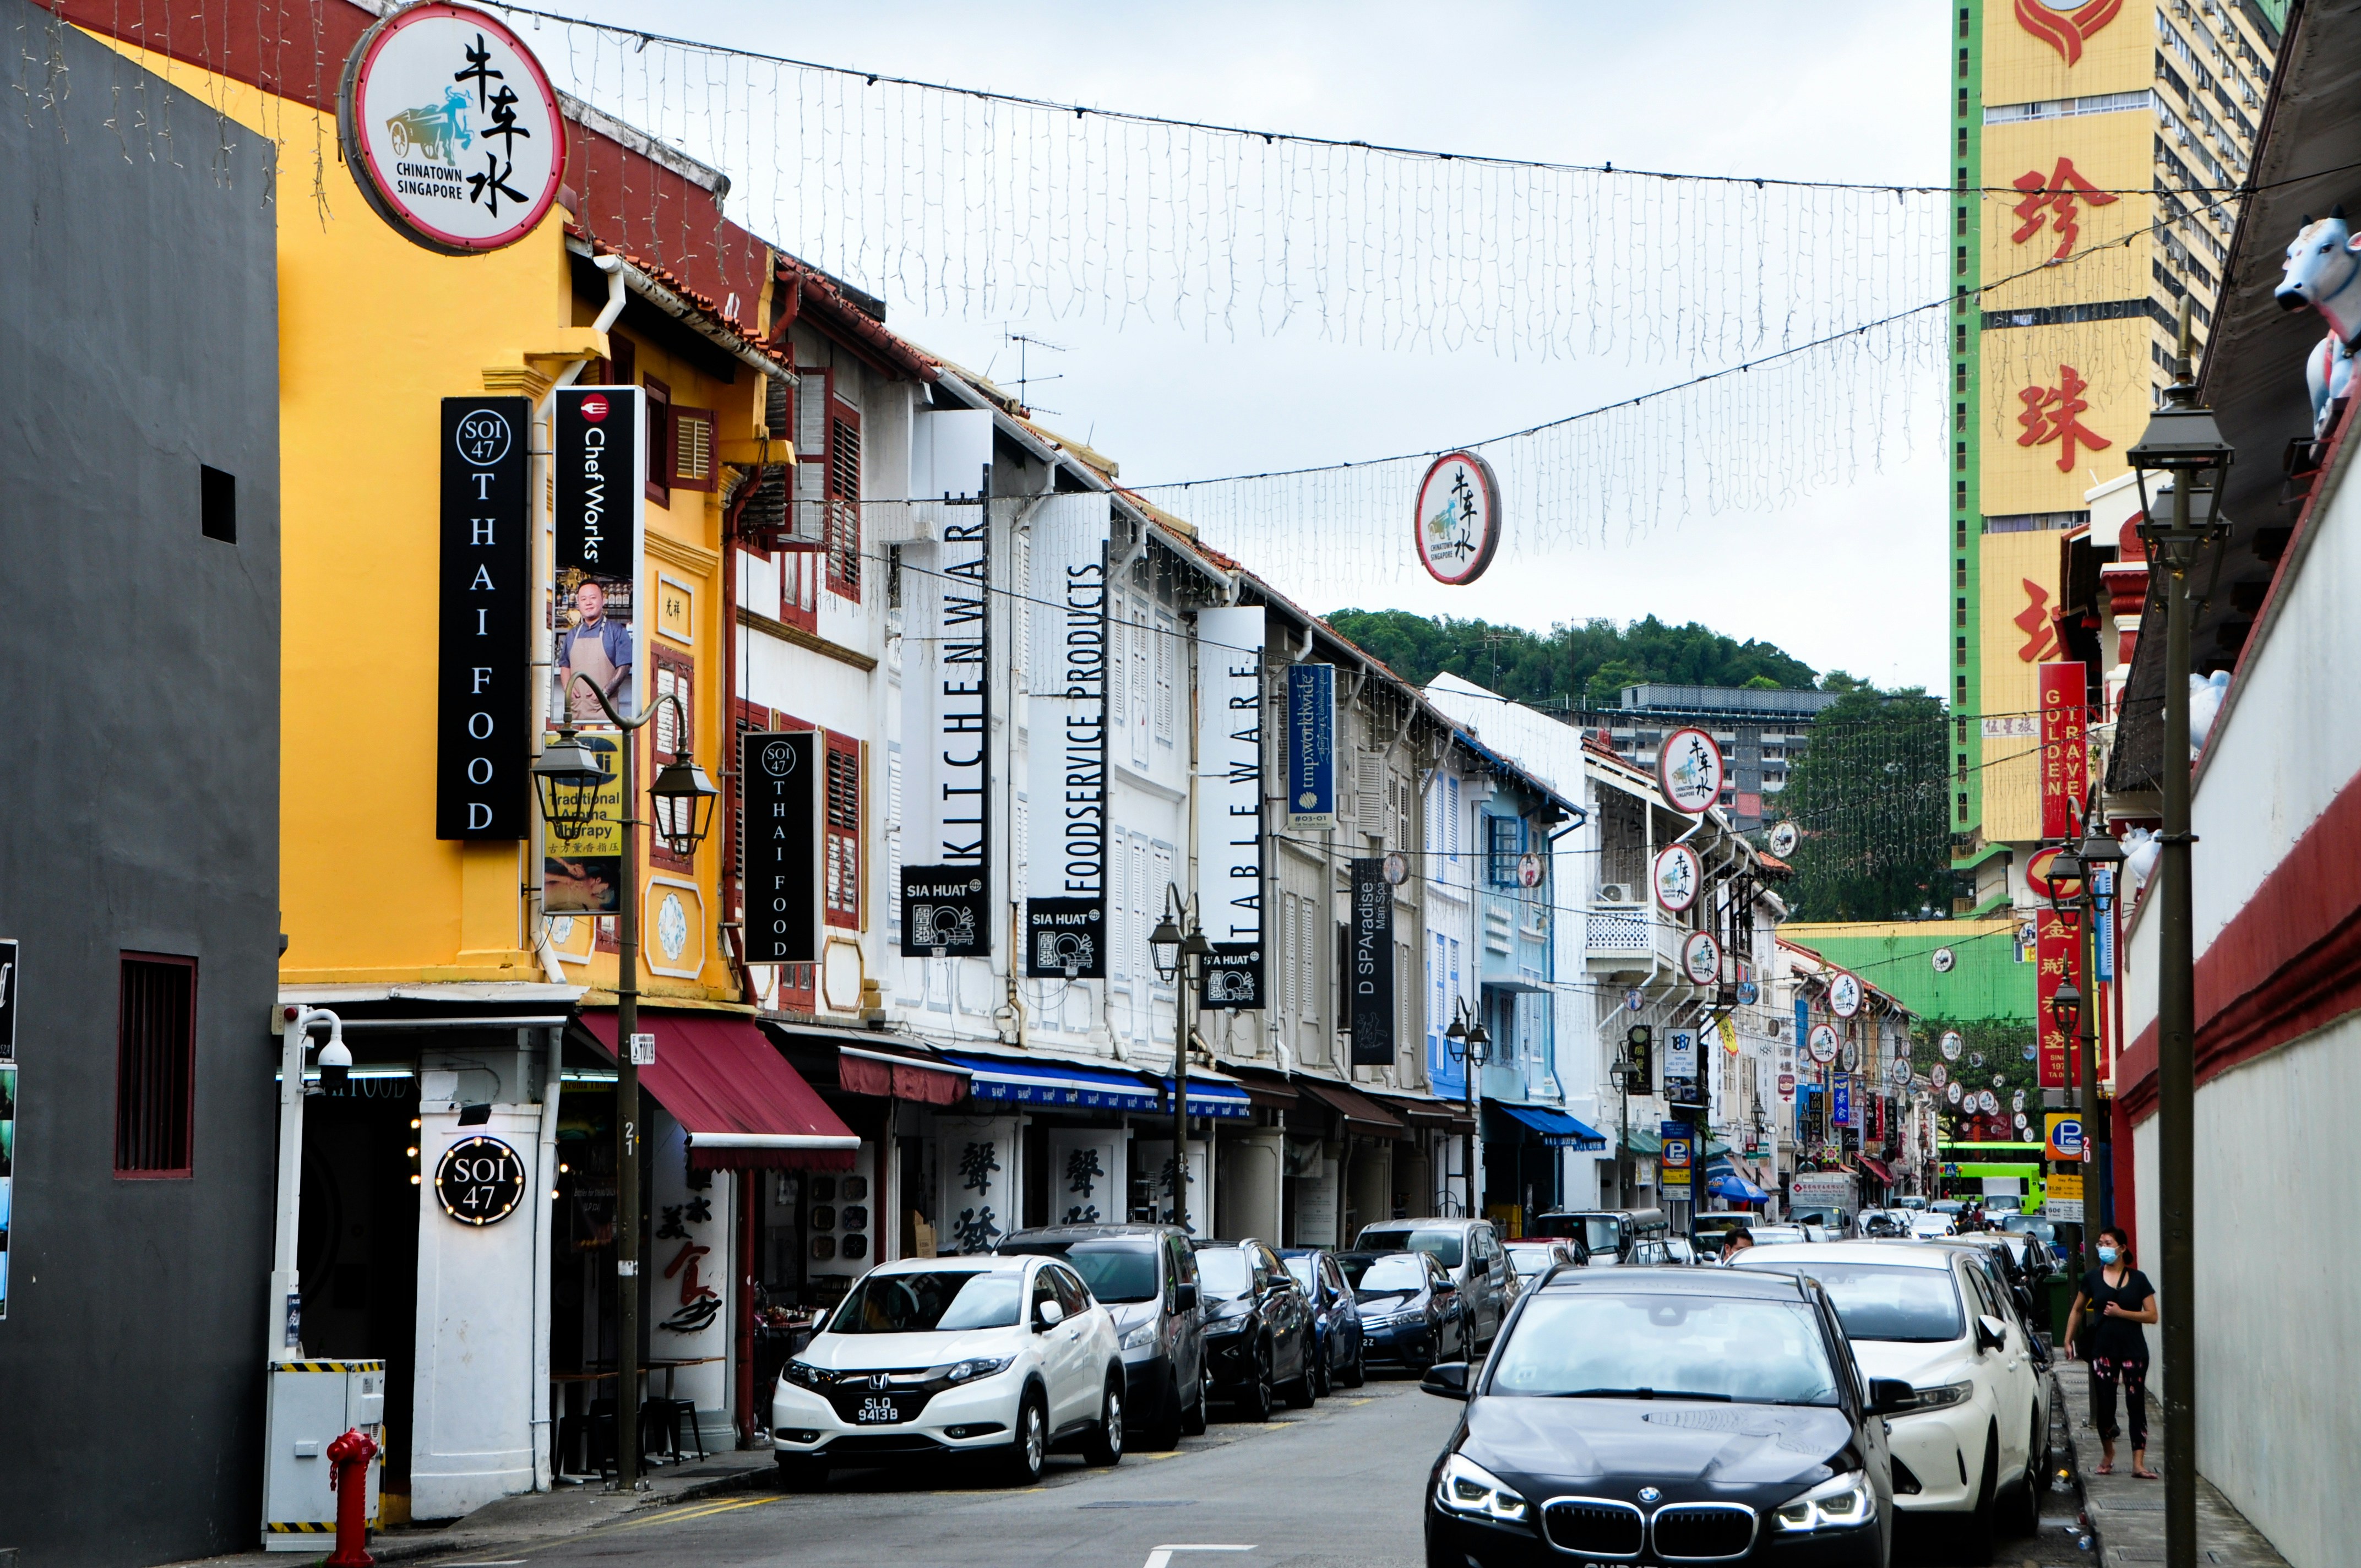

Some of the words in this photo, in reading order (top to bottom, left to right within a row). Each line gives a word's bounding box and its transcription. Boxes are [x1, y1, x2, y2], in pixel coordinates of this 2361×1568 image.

[396, 162, 462, 182] CHINATOWN
[398, 180, 462, 200] SINGAPORE
[465, 421, 502, 439] SOI
[471, 441, 494, 458] 47
[584, 427, 605, 481] Chef
[584, 484, 604, 559] Works
[469, 473, 496, 635] THAI
[1430, 541, 1452, 551] CHINATOWN
[1430, 551, 1452, 562] SINGAPORE
[1066, 564, 1102, 699] PRODUCTS
[943, 491, 983, 859] KITCHENWARE
[1297, 675, 1319, 787] tmp.worldwide
[466, 667, 493, 829] FOOD
[2046, 689, 2061, 796] GOLDEN
[768, 748, 790, 760] SOI
[771, 760, 786, 771] 47
[1065, 714, 1101, 891] FOODSERVICE
[1230, 666, 1259, 937] TABLEWARE
[773, 781, 785, 861] THAI
[907, 885, 929, 896] SIA
[933, 885, 967, 896] HUAT
[1376, 882, 1388, 903] Spa
[773, 876, 786, 956] FOOD
[1032, 914, 1053, 925] SIA
[1056, 914, 1087, 925] HUAT
[1376, 906, 1385, 929] Man
[1359, 882, 1374, 975] SPAradise
[1223, 956, 1249, 965] HUAT
[1359, 981, 1374, 994] D
[1671, 1034, 1691, 1051] 1887
[591, 1082, 617, 1091] Therap
[625, 1122, 634, 1156] 21
[2060, 1123, 2081, 1145] P
[1669, 1143, 1685, 1158] P
[2083, 1136, 2090, 1163] 20
[454, 1159, 506, 1183] SOI
[1179, 1152, 1184, 1174] 19
[463, 1186, 495, 1209] 47
[858, 1408, 898, 1420] 9413B
[864, 1397, 891, 1409] SLQ
